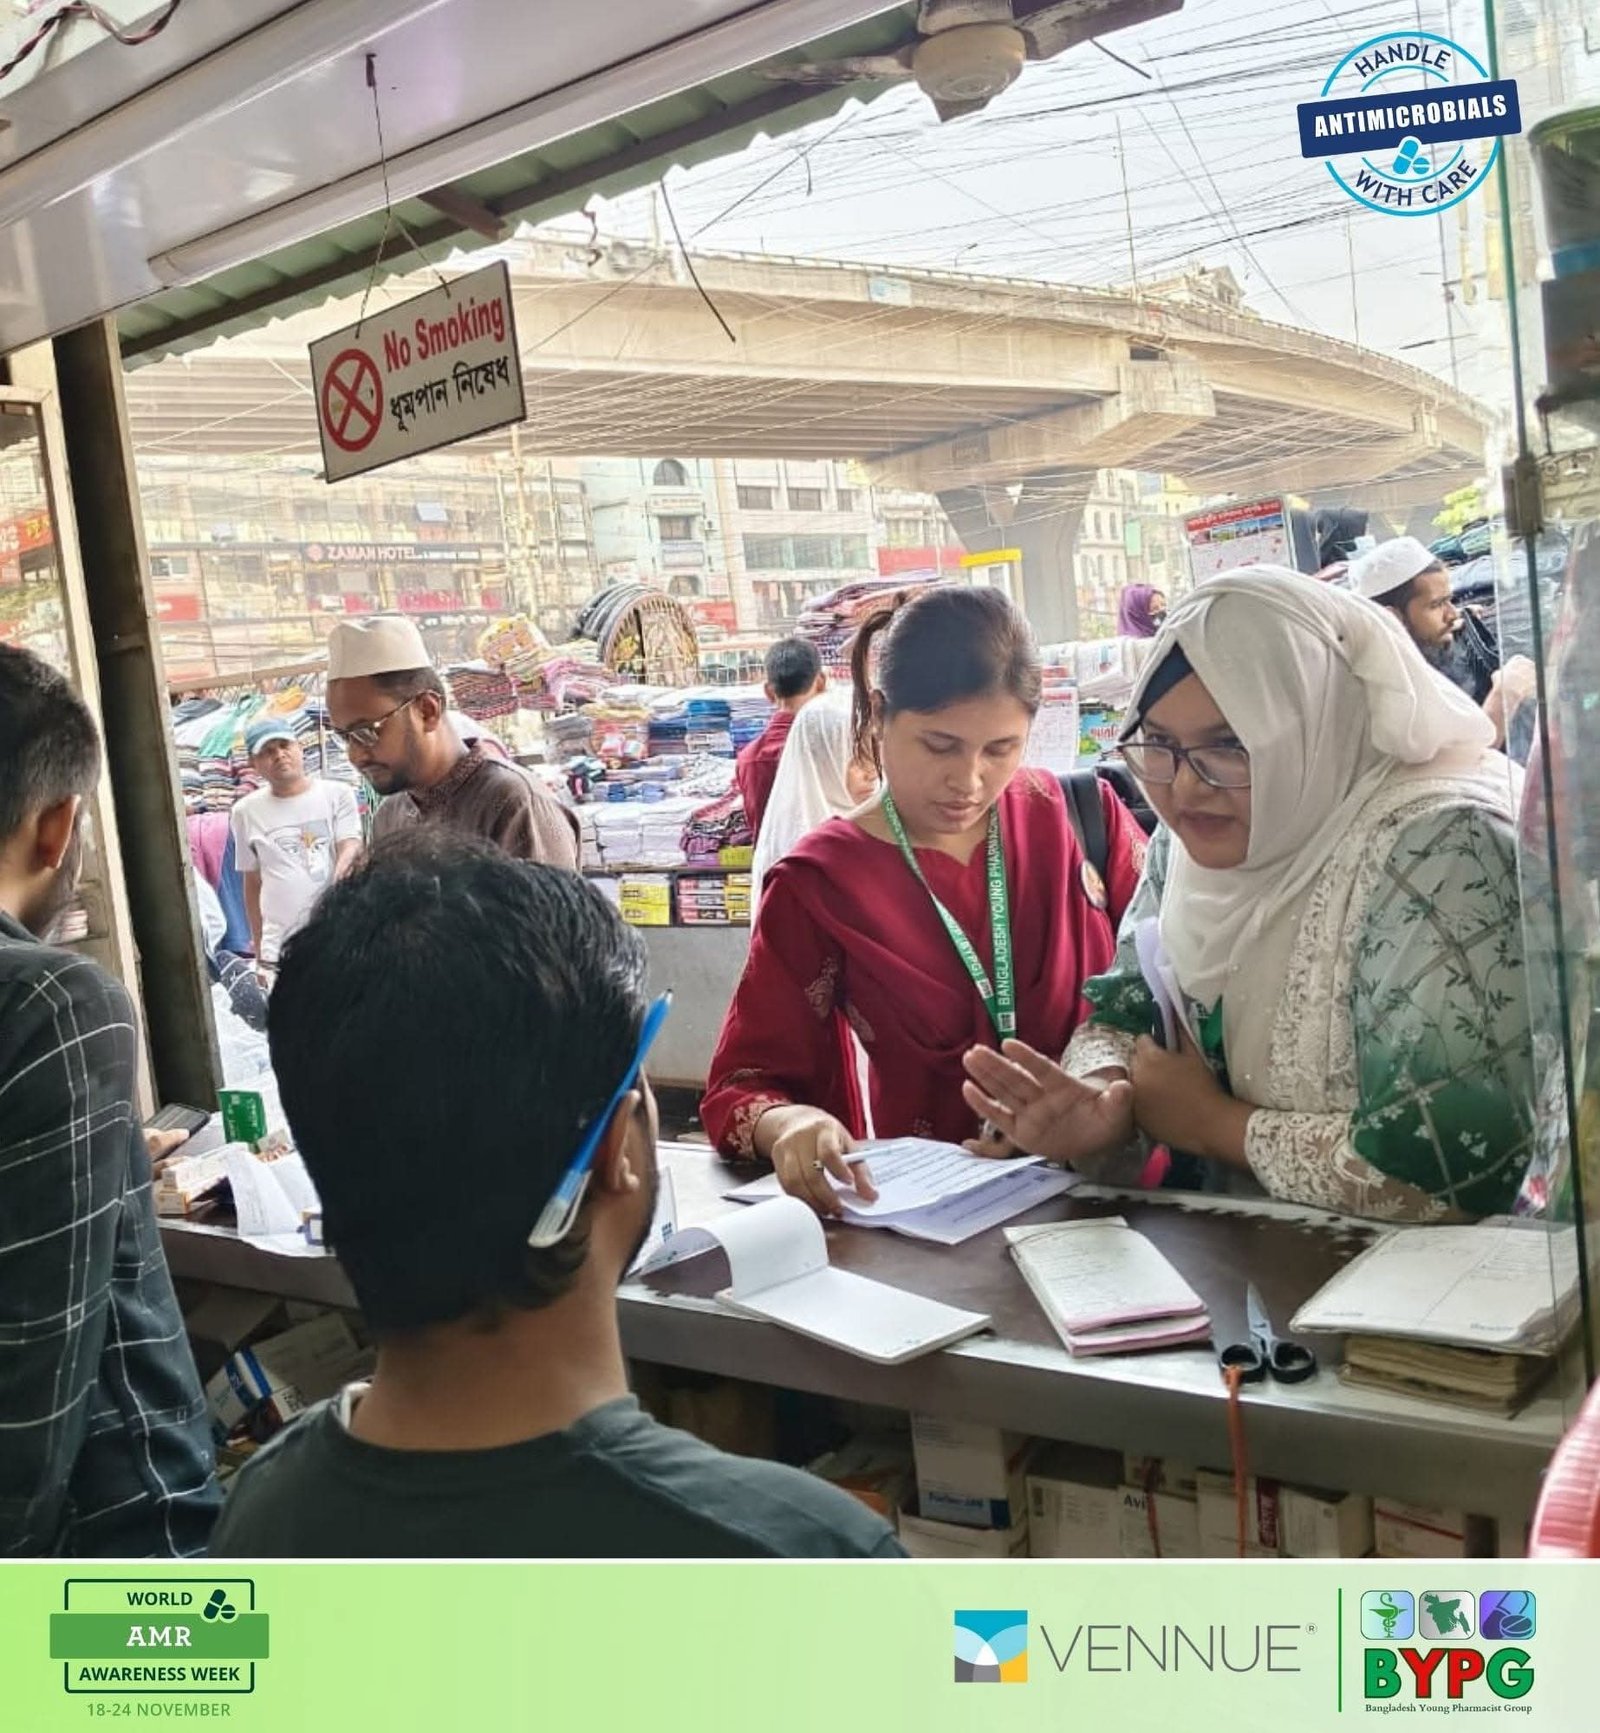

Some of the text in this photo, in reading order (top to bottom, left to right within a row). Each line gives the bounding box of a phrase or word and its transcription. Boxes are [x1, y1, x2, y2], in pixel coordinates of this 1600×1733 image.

[383, 297, 505, 372] No Smoking
[390, 356, 511, 432] ধূমপান নিষেধ
[328, 546, 376, 560] ZAMAN
[378, 546, 416, 559] HOTEL
[989, 879, 1006, 918] YOUNG
[992, 918, 1011, 1005] BANGLADESH
